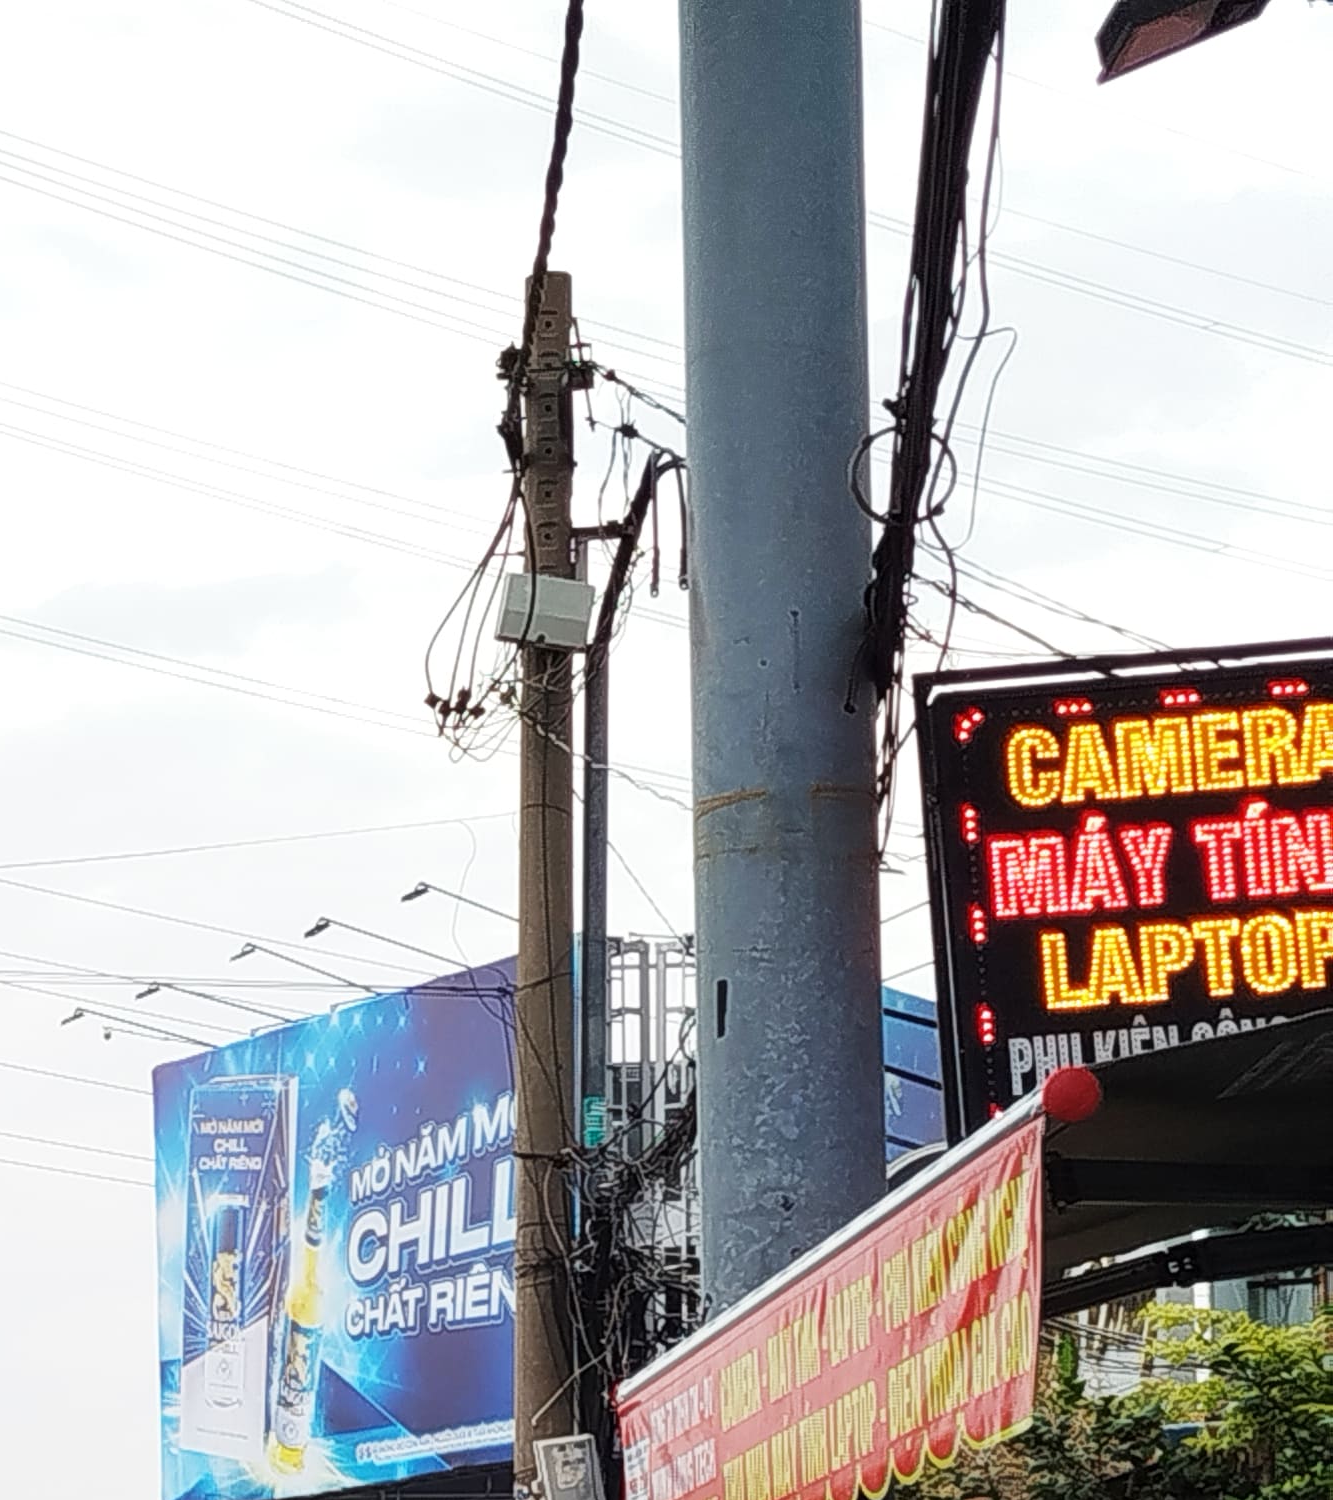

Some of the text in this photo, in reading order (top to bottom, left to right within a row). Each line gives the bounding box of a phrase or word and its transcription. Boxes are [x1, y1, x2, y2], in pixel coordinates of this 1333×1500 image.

[987, 810, 1173, 919] MÁY
[350, 1148, 392, 1201] MỞ
[395, 1124, 467, 1184] NĂM
[346, 1262, 516, 1337] CHẤT RIÊN
